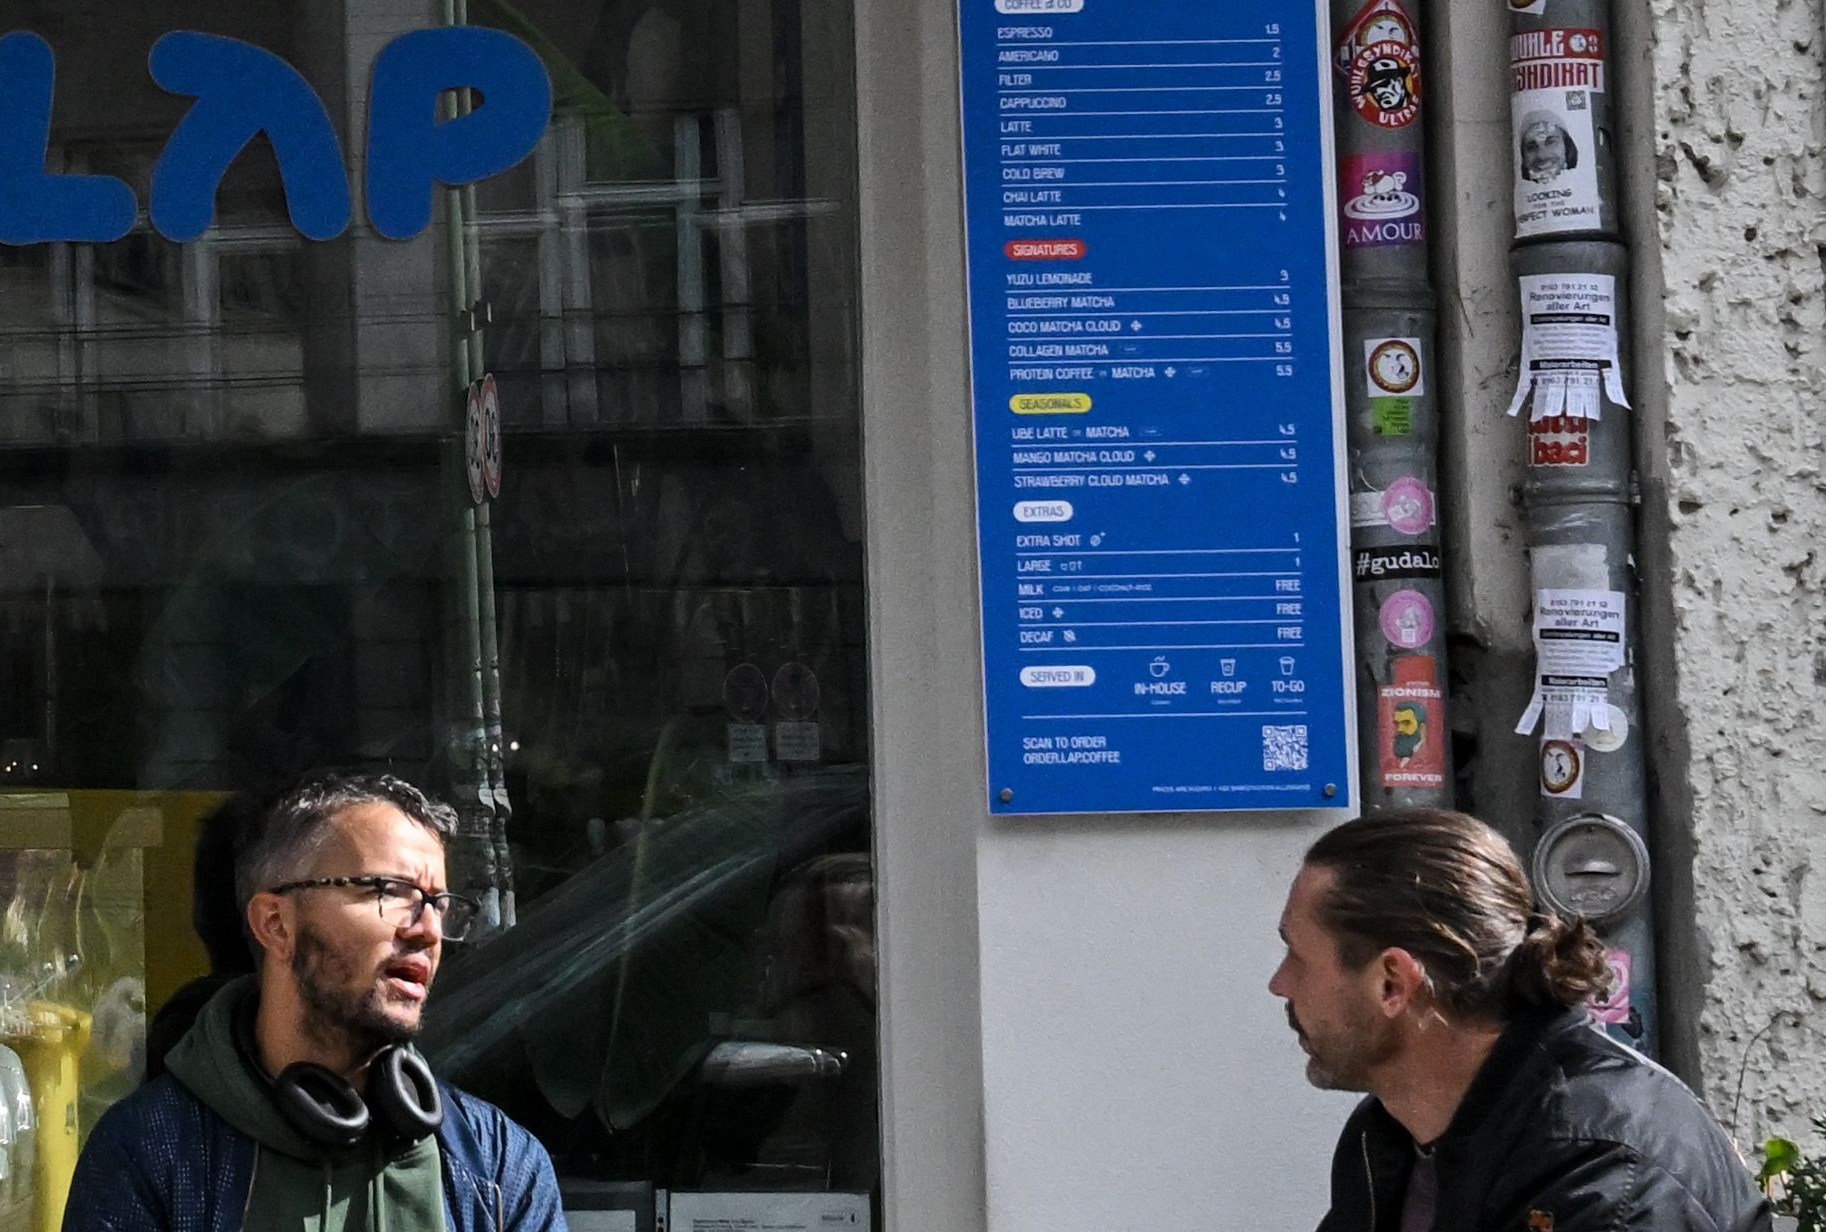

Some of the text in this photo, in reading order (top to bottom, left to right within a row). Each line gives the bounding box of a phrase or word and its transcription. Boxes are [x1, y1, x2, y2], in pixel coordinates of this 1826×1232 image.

[997, 24, 1280, 39] ESPRESSO 1.5
[998, 47, 1280, 62] AMERICANO 2
[999, 70, 1281, 86] FILTER 2.5
[1000, 97, 1066, 109] CAPPUCCINO
[1000, 117, 1283, 133] LATTE 3
[1001, 145, 1026, 156] FLAT
[1028, 144, 1061, 155] WHITE
[1002, 168, 1030, 180] COLD
[1032, 167, 1065, 179] BREW
[1003, 191, 1028, 203] CHAI
[1030, 190, 1062, 202] LATTE
[1004, 214, 1048, 226] MATCHA
[1050, 213, 1081, 225] LATTE
[1346, 222, 1423, 245] AMOUR
[1012, 244, 1078, 256] SIGNATURES
[1006, 273, 1034, 285] YUZU
[1036, 272, 1092, 285] LEMONADE
[1007, 296, 1068, 309] BLUEBERRY
[1071, 296, 1115, 308] MATCHA
[1529, 291, 1611, 304] Renovierungen
[1546, 301, 1591, 311] aller Art
[1008, 321, 1037, 333] COCO
[1040, 320, 1083, 333] MATCHA
[1085, 320, 1121, 332] CLOUD
[1009, 345, 1062, 357] COLLAGEN
[1064, 344, 1109, 356] MATCHA
[1010, 368, 1053, 380] PROTEIN
[1055, 367, 1094, 379] COFFEE
[1111, 367, 1156, 379] MATCHA
[1018, 397, 1082, 410] SEASONALS
[1011, 427, 1034, 440] UBE
[1037, 427, 1068, 439] LATTE
[1085, 426, 1129, 438] MATCHA
[1013, 451, 1051, 464] MANGO
[1053, 450, 1097, 463] MATCHA
[1099, 450, 1135, 462] CLOUD
[1014, 475, 1085, 488] STRAWBERRY
[1087, 474, 1123, 487] CLOUD
[1125, 473, 1169, 486] MATCHA
[1023, 506, 1065, 517] EXTRAS
[1016, 535, 1051, 547] EXTRA
[1053, 534, 1081, 546] SHOT
[1017, 559, 1051, 571] LARGE
[1018, 583, 1044, 595] MILK
[1275, 579, 1301, 591] FREE
[1019, 603, 1301, 619] ICED FREE
[1540, 607, 1620, 619] Renovierungen
[1555, 617, 1599, 628] aller Art
[1020, 627, 1303, 643] DECAF FREE
[1030, 670, 1084, 682] SERVED IN
[1134, 682, 1187, 695] IN-HOUSE
[1210, 681, 1247, 693] RECUP
[1271, 680, 1305, 692] TO-GO
[1022, 736, 1107, 750] SCAN TO ORDER
[1385, 773, 1443, 787] FOREVER
